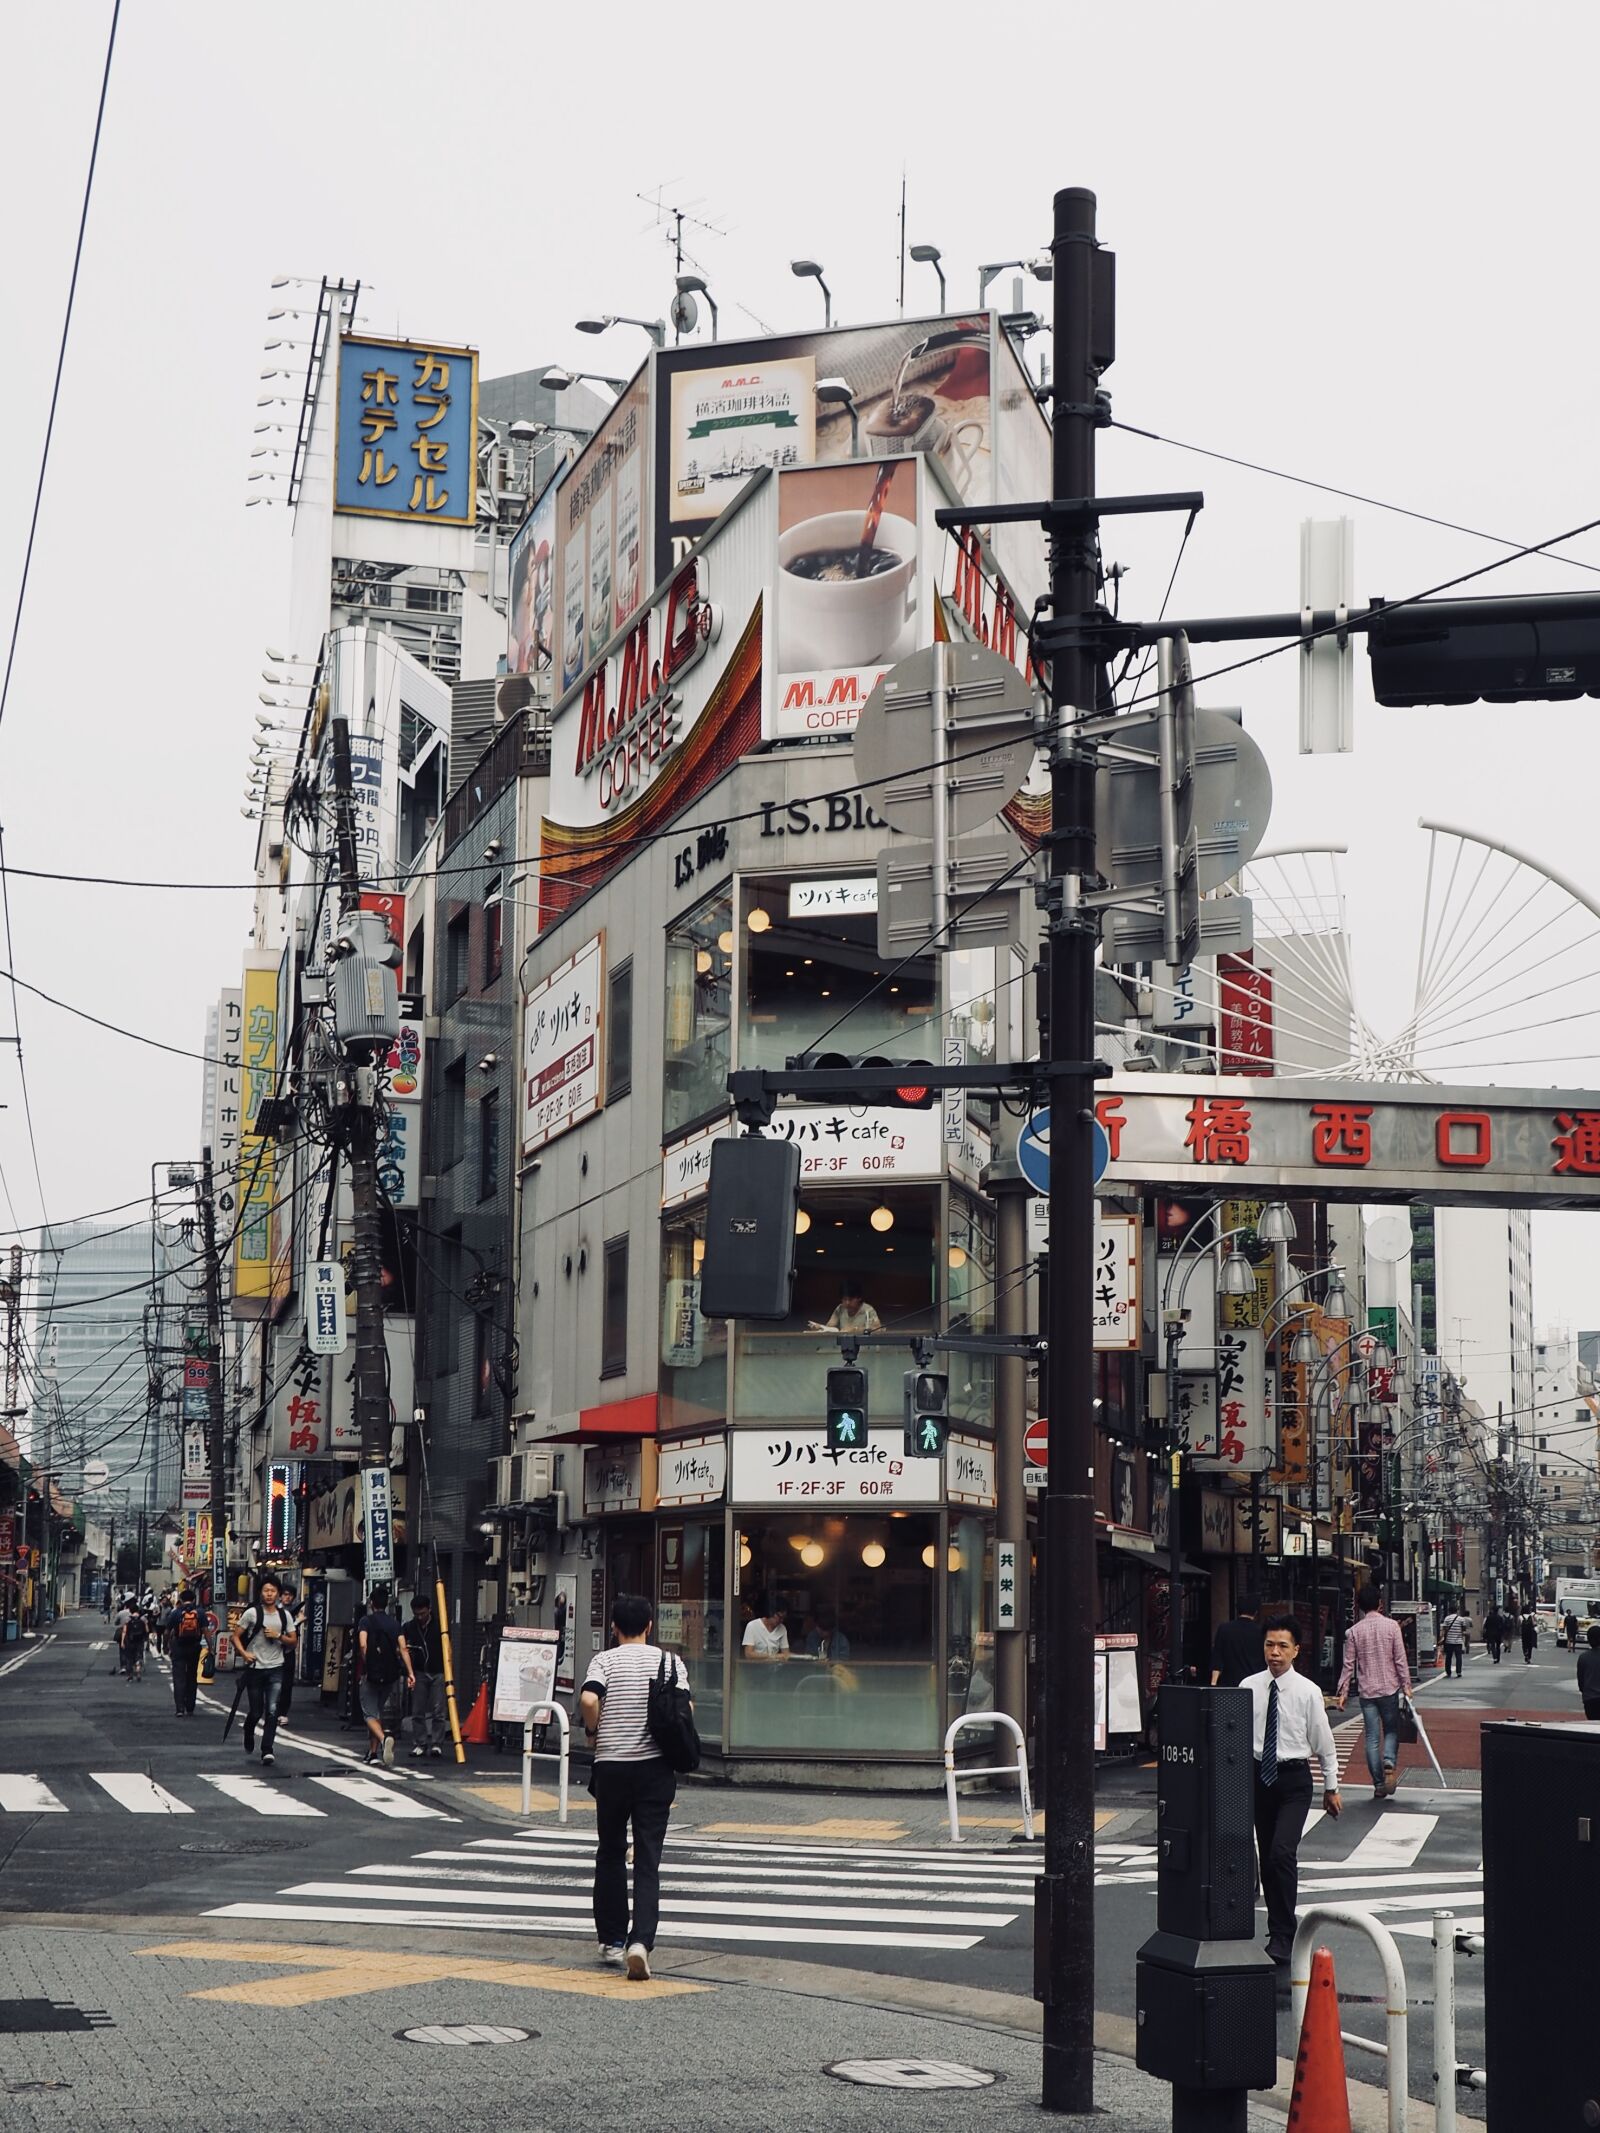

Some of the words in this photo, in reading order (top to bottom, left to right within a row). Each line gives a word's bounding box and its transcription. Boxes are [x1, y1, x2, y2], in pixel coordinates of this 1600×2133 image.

[357, 367, 400, 487] ホテル
[409, 352, 452, 513] カプセル
[806, 708, 864, 729] COFF
[600, 692, 683, 812] COFFEE
[761, 799, 820, 837] I.S.
[550, 990, 582, 1047] ツバキ
[1230, 1003, 1244, 1052] 美顔教室
[220, 1001, 240, 1178] カプセルホテル
[861, 1155, 896, 1171] 60席
[318, 1266, 333, 1284] 質
[319, 1294, 335, 1336] セキネ
[370, 1473, 386, 1489] 質
[859, 1480, 894, 1496] 60席
[373, 1511, 388, 1560] セキネ
[999, 1553, 1015, 1618] 共栄会
[313, 1604, 324, 1633] BOSS
[1161, 1743, 1195, 1764] 108-54
